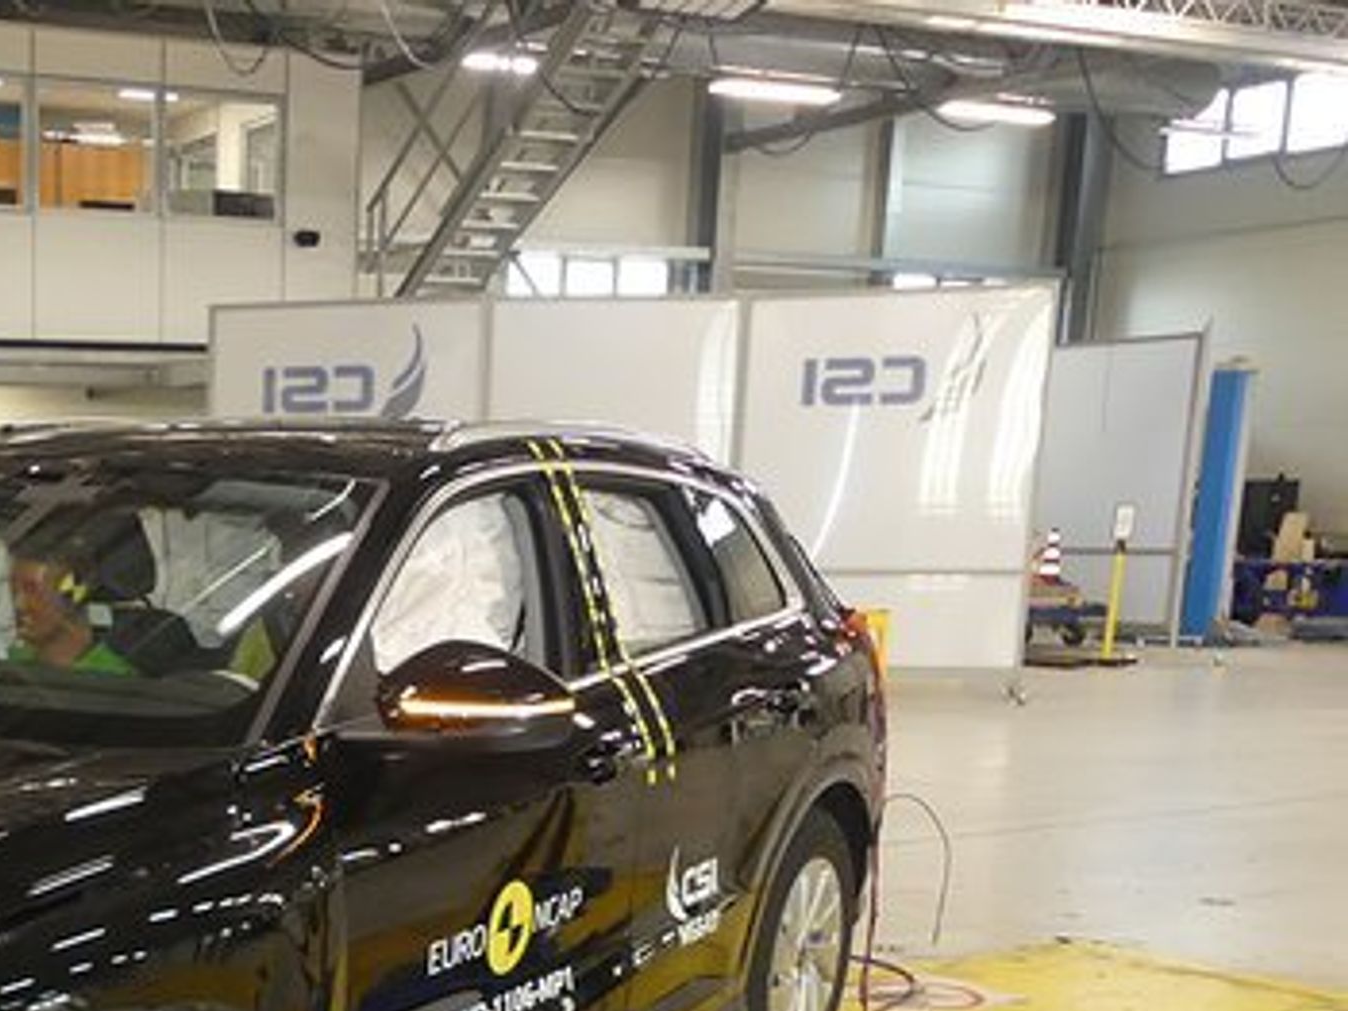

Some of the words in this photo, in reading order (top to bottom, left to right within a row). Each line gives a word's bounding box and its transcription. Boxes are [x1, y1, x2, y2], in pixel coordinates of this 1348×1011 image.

[682, 858, 718, 906] CSI
[427, 924, 487, 976] EURO
[533, 887, 583, 932] NCAP
